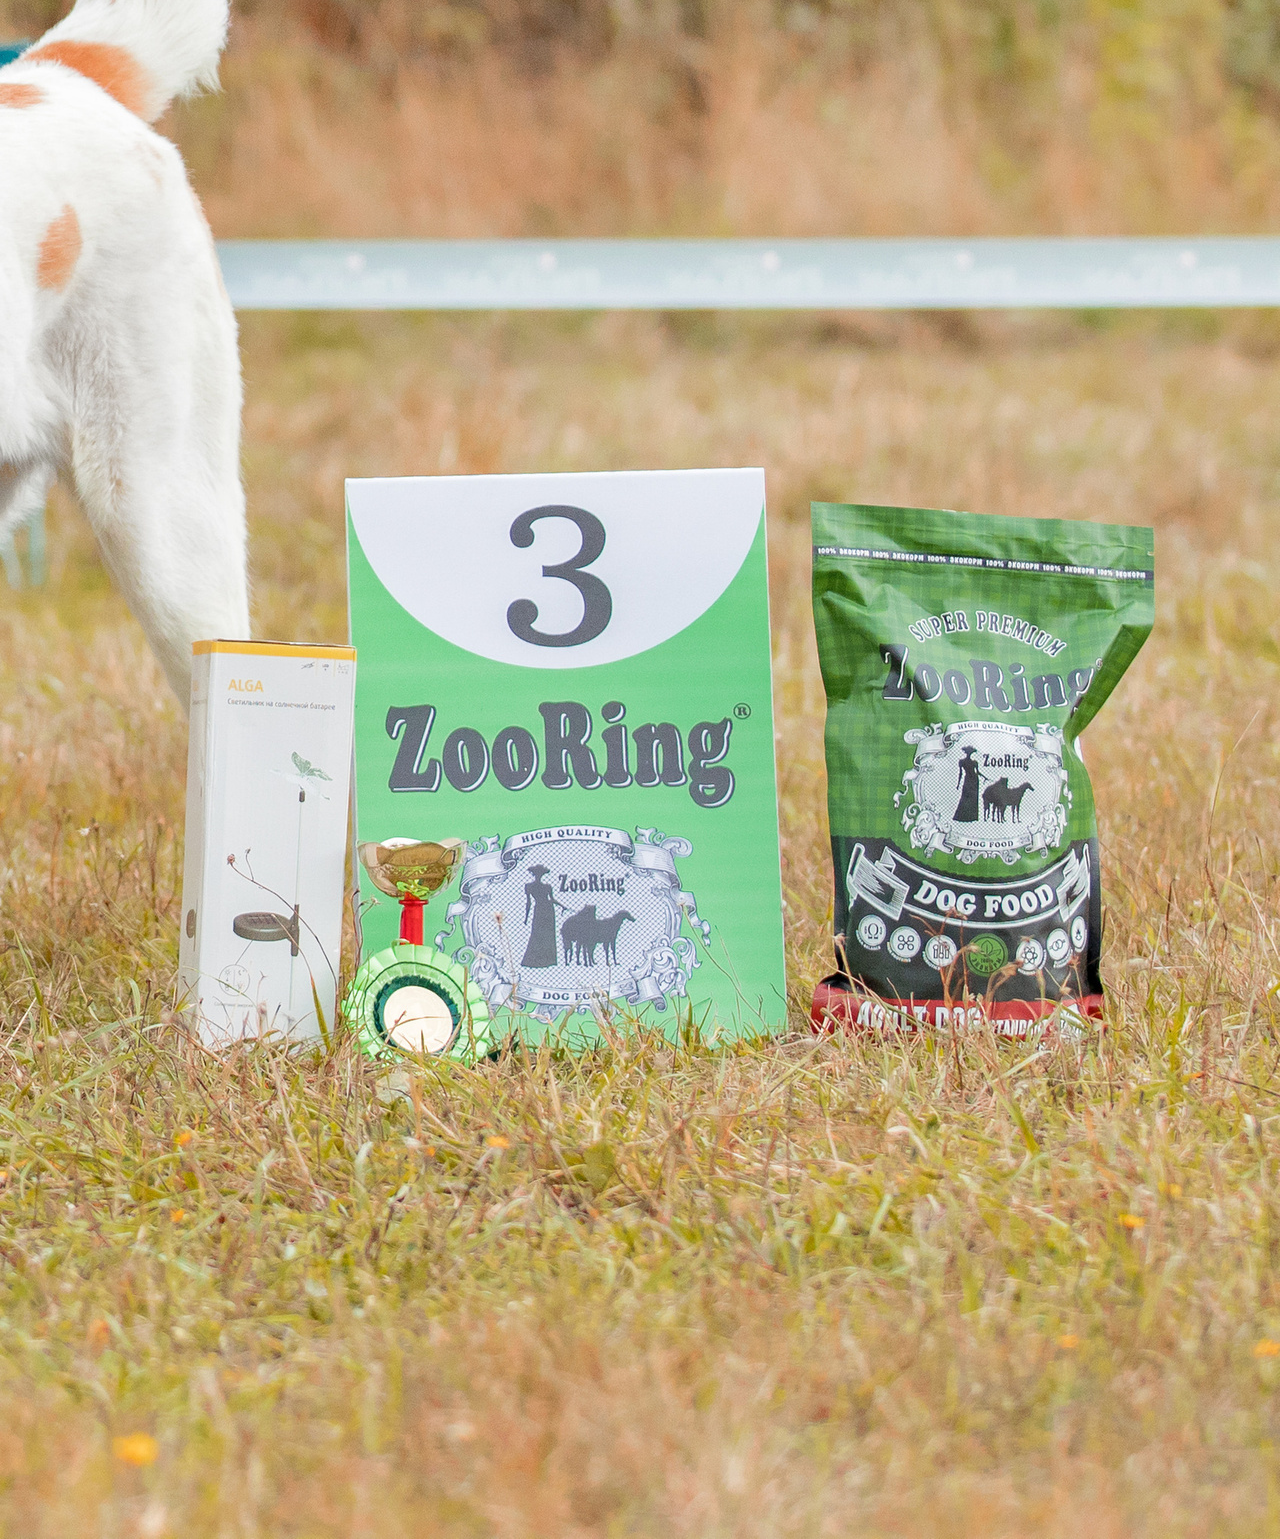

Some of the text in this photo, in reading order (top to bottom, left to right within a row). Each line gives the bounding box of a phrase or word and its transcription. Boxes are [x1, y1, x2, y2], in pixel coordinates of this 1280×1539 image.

[506, 504, 613, 648] 3
[908, 610, 1067, 658] SUPER PREMIUM
[228, 679, 264, 693] ALGA
[227, 697, 336, 711] Светильник на солнечной батарее
[958, 722, 1020, 733] HIGH QUALITY
[521, 828, 613, 843] HIGH QUALITY
[966, 840, 1014, 848] DOG FOOD
[913, 880, 1054, 918] DOG FOOD
[542, 991, 569, 1001] DOG
